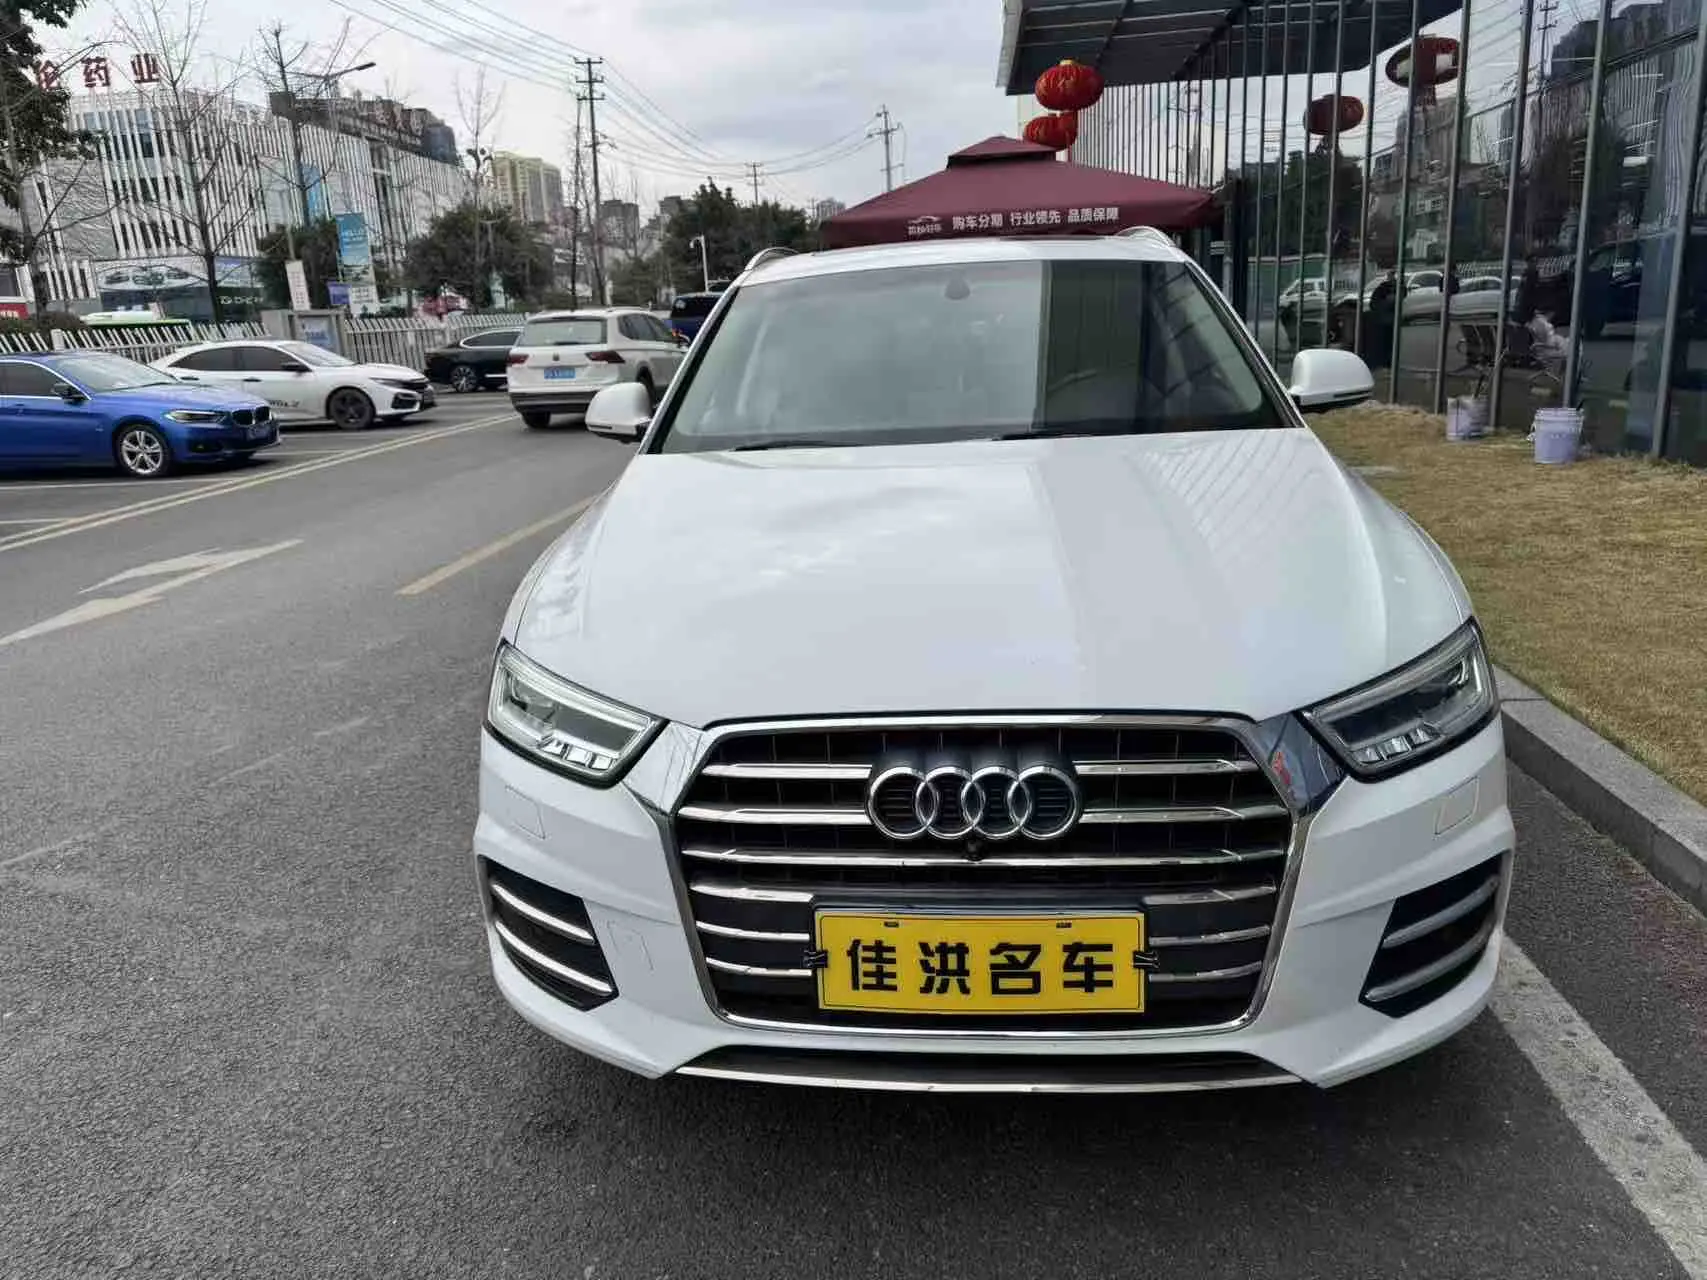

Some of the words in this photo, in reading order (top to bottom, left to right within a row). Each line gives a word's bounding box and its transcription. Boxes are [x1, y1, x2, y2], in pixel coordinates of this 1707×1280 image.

[952, 213, 1004, 230] 购车分期
[1010, 211, 1061, 226] 行业领先
[1067, 207, 1119, 222] 品质保障
[847, 938, 1114, 996] 佳洪名车
